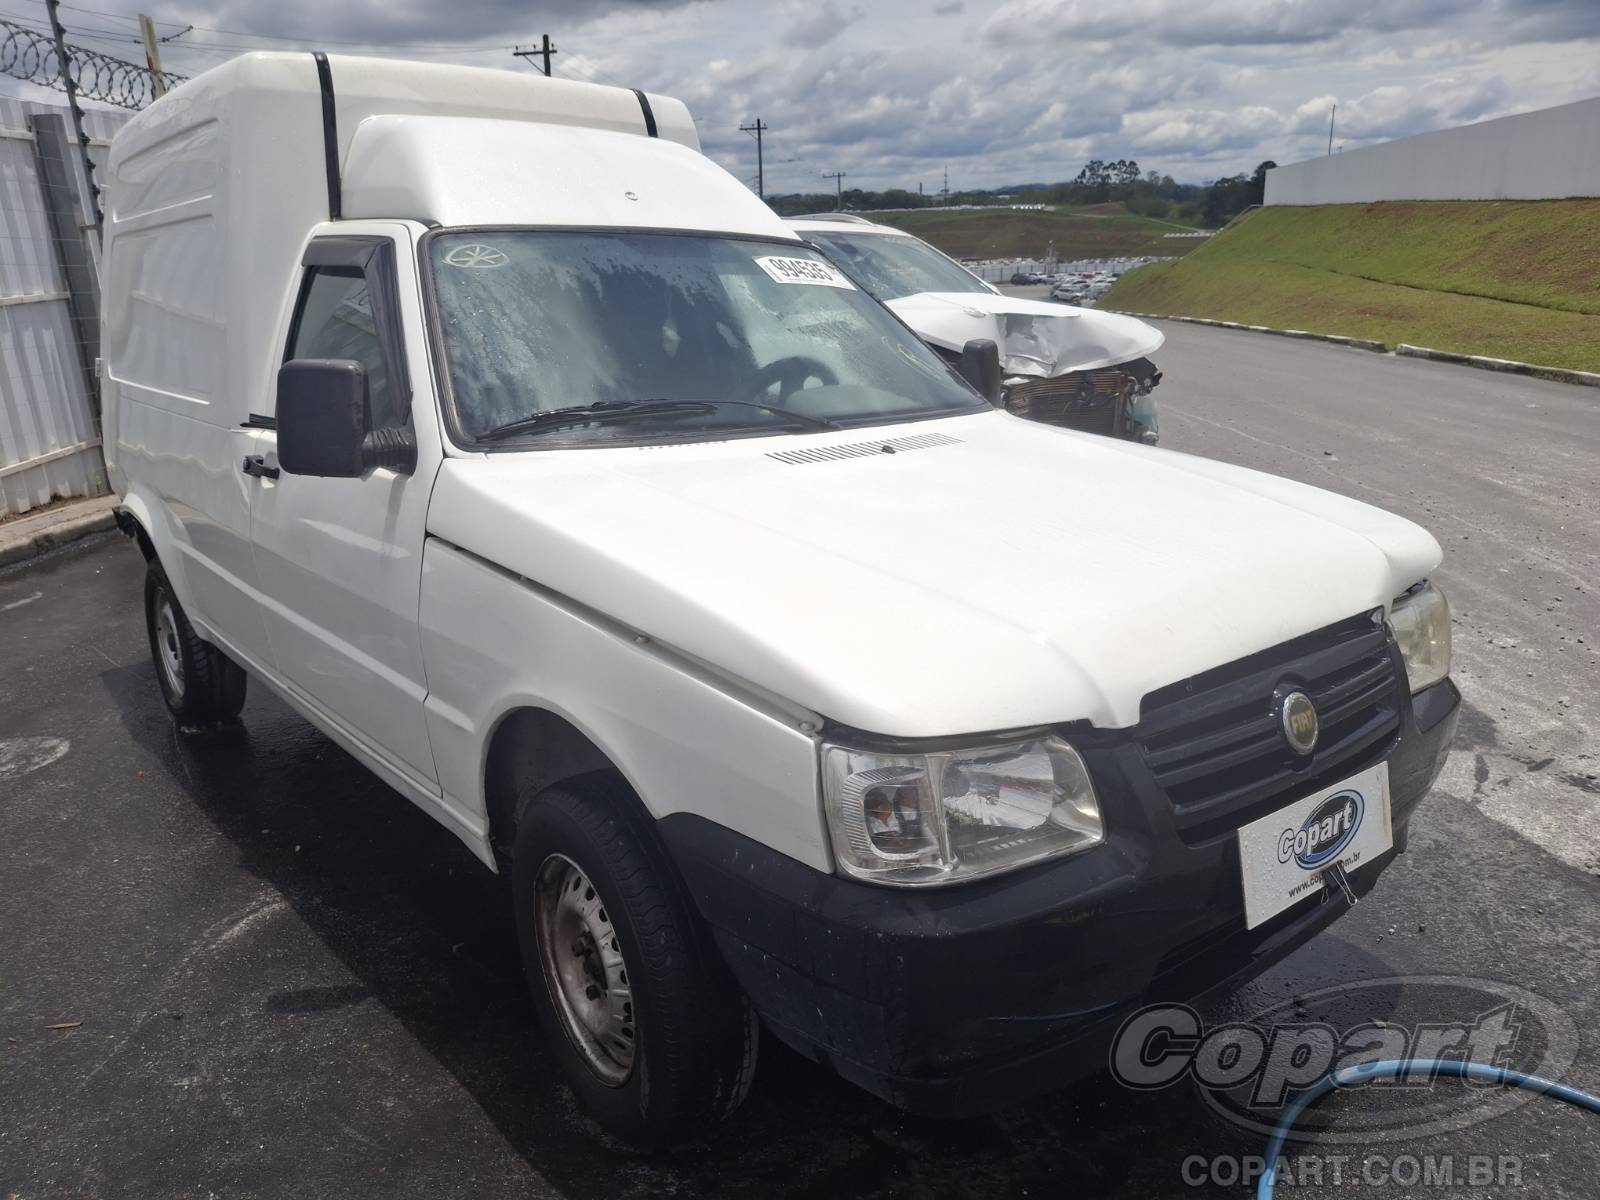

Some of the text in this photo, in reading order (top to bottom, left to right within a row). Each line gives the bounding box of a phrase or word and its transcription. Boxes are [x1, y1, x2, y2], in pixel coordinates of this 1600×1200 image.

[768, 258, 833, 281] 994535
[1290, 709, 1313, 735] FIAT
[1277, 799, 1354, 865] Copart
[1288, 851, 1361, 898] www.copom.br
